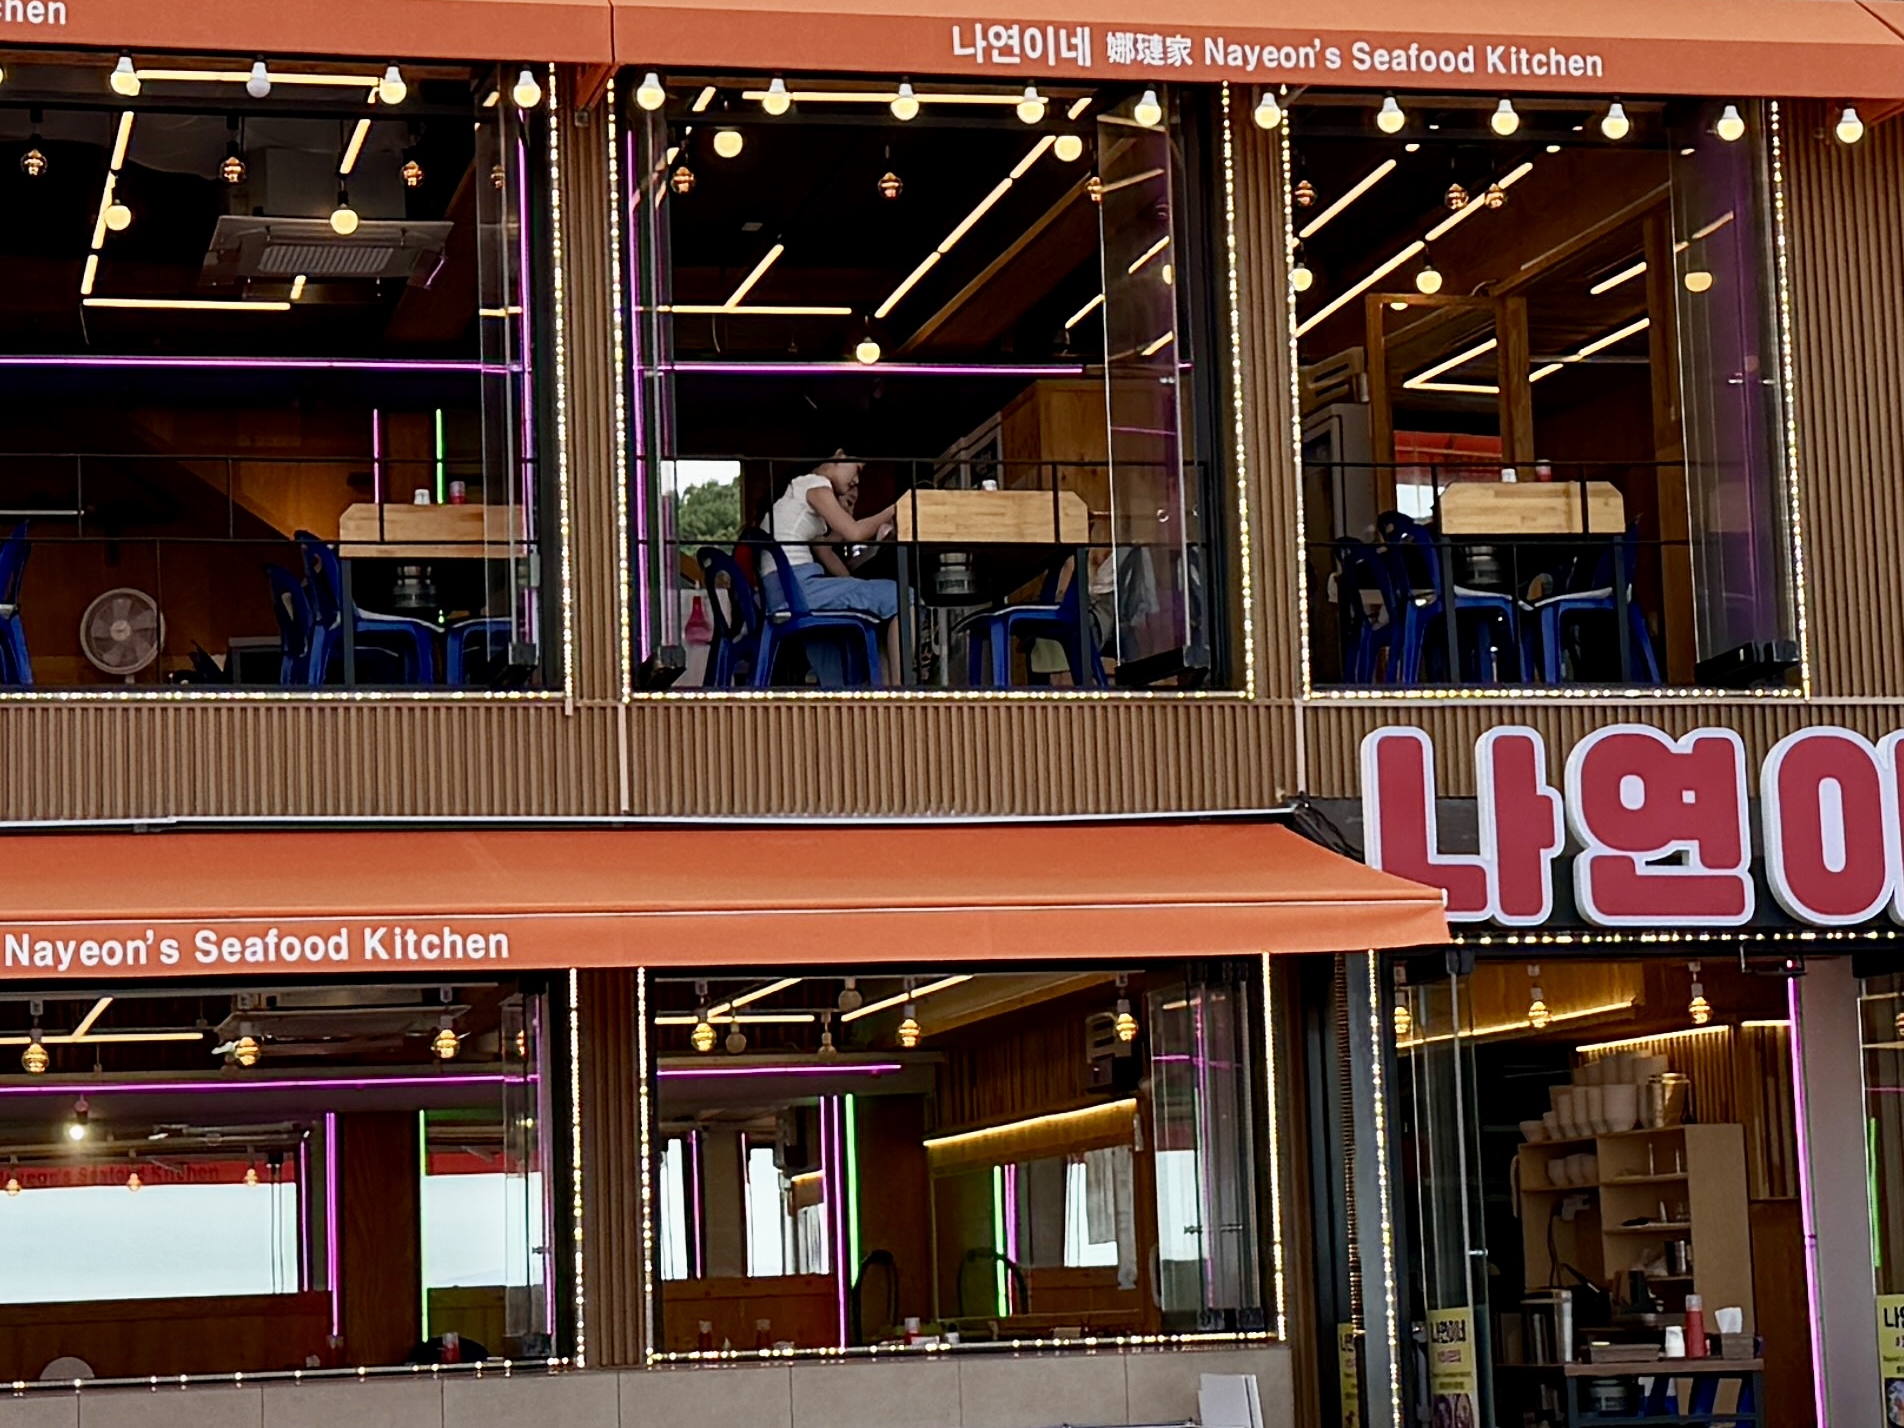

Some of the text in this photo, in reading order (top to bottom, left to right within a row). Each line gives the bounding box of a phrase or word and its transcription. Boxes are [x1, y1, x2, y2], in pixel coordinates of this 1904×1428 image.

[950, 22, 1093, 68] 나연이네
[1202, 33, 1342, 74] Nayeon's
[1351, 39, 1476, 76] Seafood
[1485, 43, 1604, 78] Kitchen
[3, 931, 181, 971] Nayeon's
[193, 929, 349, 965] Seafood
[361, 925, 510, 962] Kitchen
